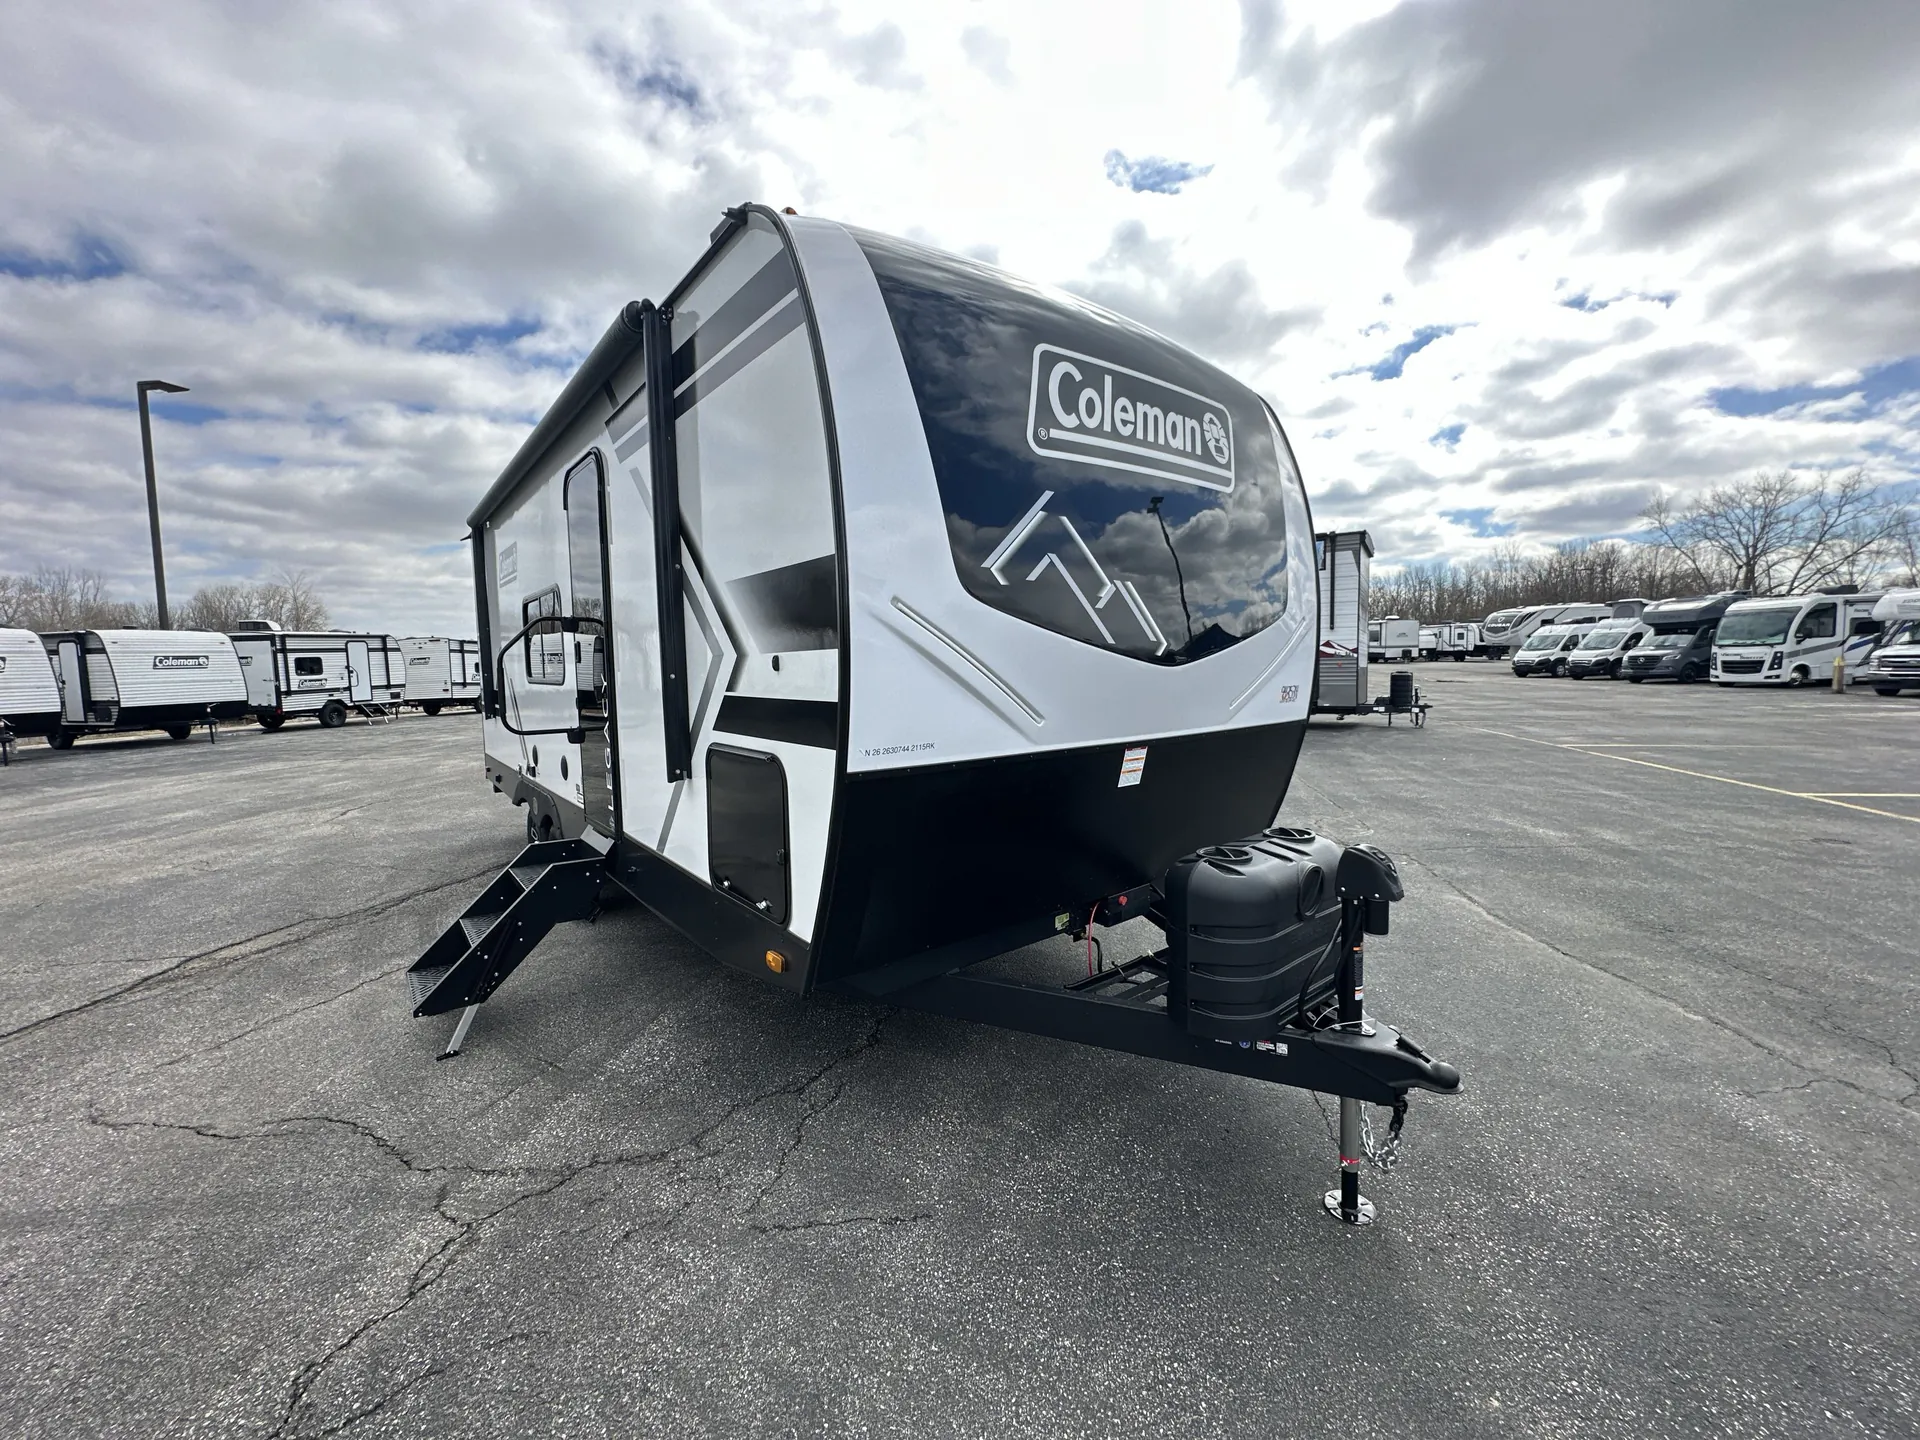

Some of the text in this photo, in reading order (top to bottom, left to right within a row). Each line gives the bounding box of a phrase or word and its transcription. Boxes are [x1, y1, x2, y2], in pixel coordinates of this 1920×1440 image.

[1048, 361, 1201, 455] Coleman
[155, 656, 199, 666] Coleman
[600, 673, 614, 811] LEGACY
[872, 748, 881, 756] 26
[882, 745, 910, 755] 2630744
[911, 743, 935, 751] 2115RK
